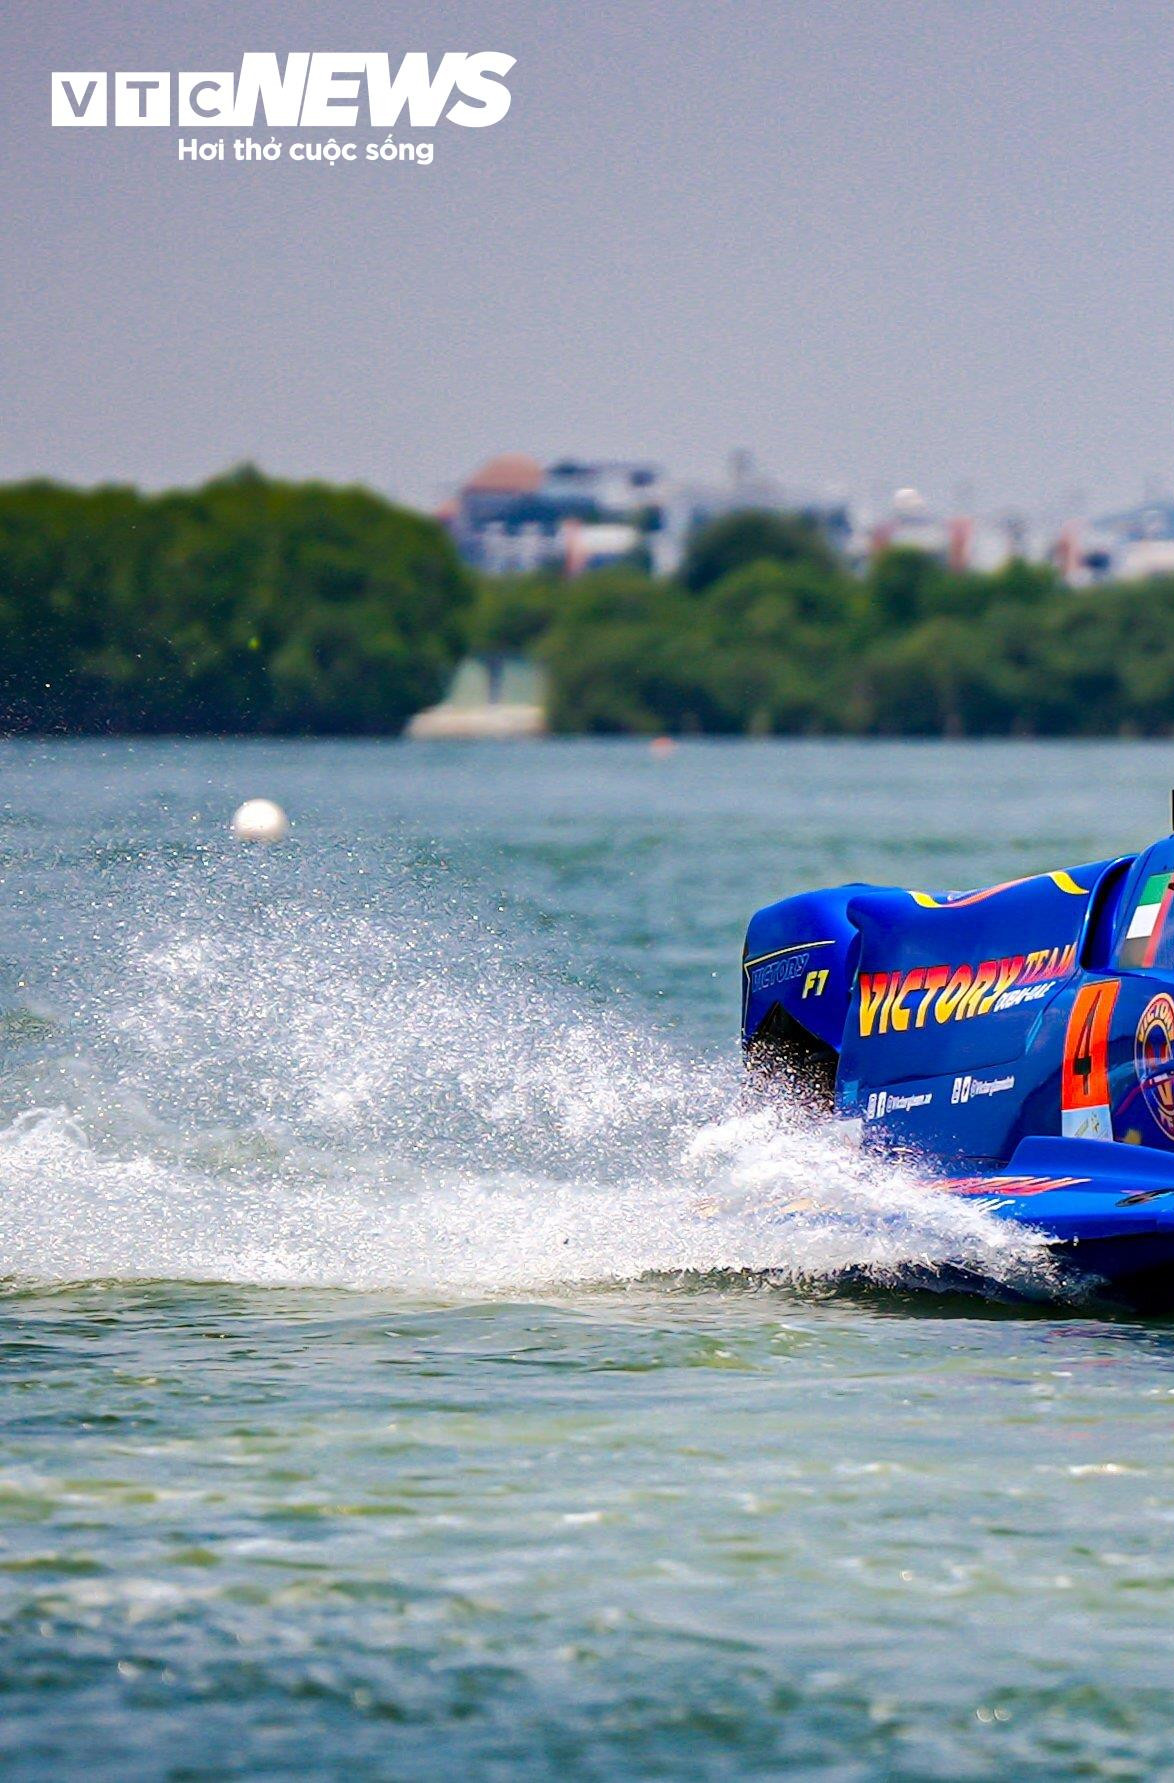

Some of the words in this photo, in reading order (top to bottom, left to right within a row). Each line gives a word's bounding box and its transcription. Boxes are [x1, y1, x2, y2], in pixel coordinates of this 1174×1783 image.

[802, 969, 829, 999] F1
[858, 954, 1025, 1038] VICTORY
[1015, 941, 1078, 986] TEAM
[1073, 989, 1103, 1096] 4
